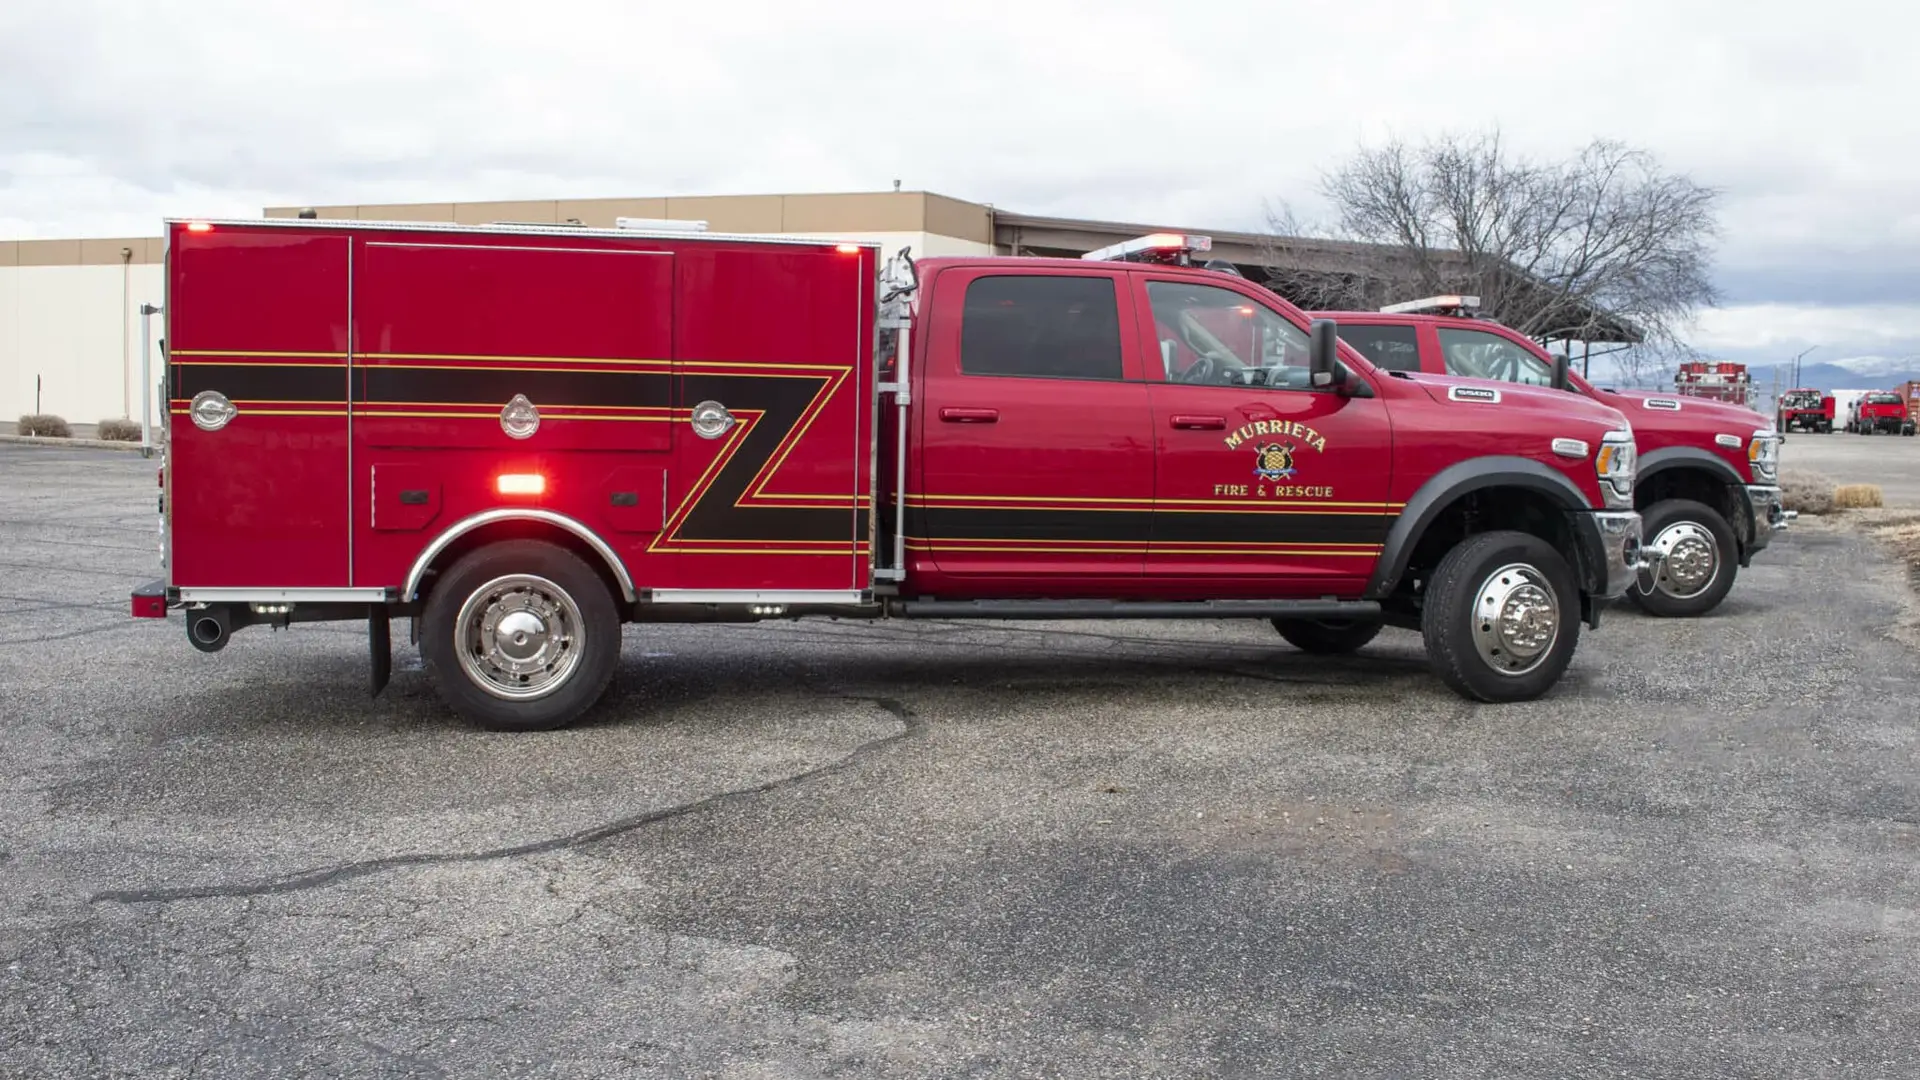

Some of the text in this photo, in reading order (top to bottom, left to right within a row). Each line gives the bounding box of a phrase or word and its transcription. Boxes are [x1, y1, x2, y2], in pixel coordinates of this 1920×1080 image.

[1224, 419, 1326, 453] MURRIETA
[1214, 484, 1334, 497] FIRE & RESCUE
